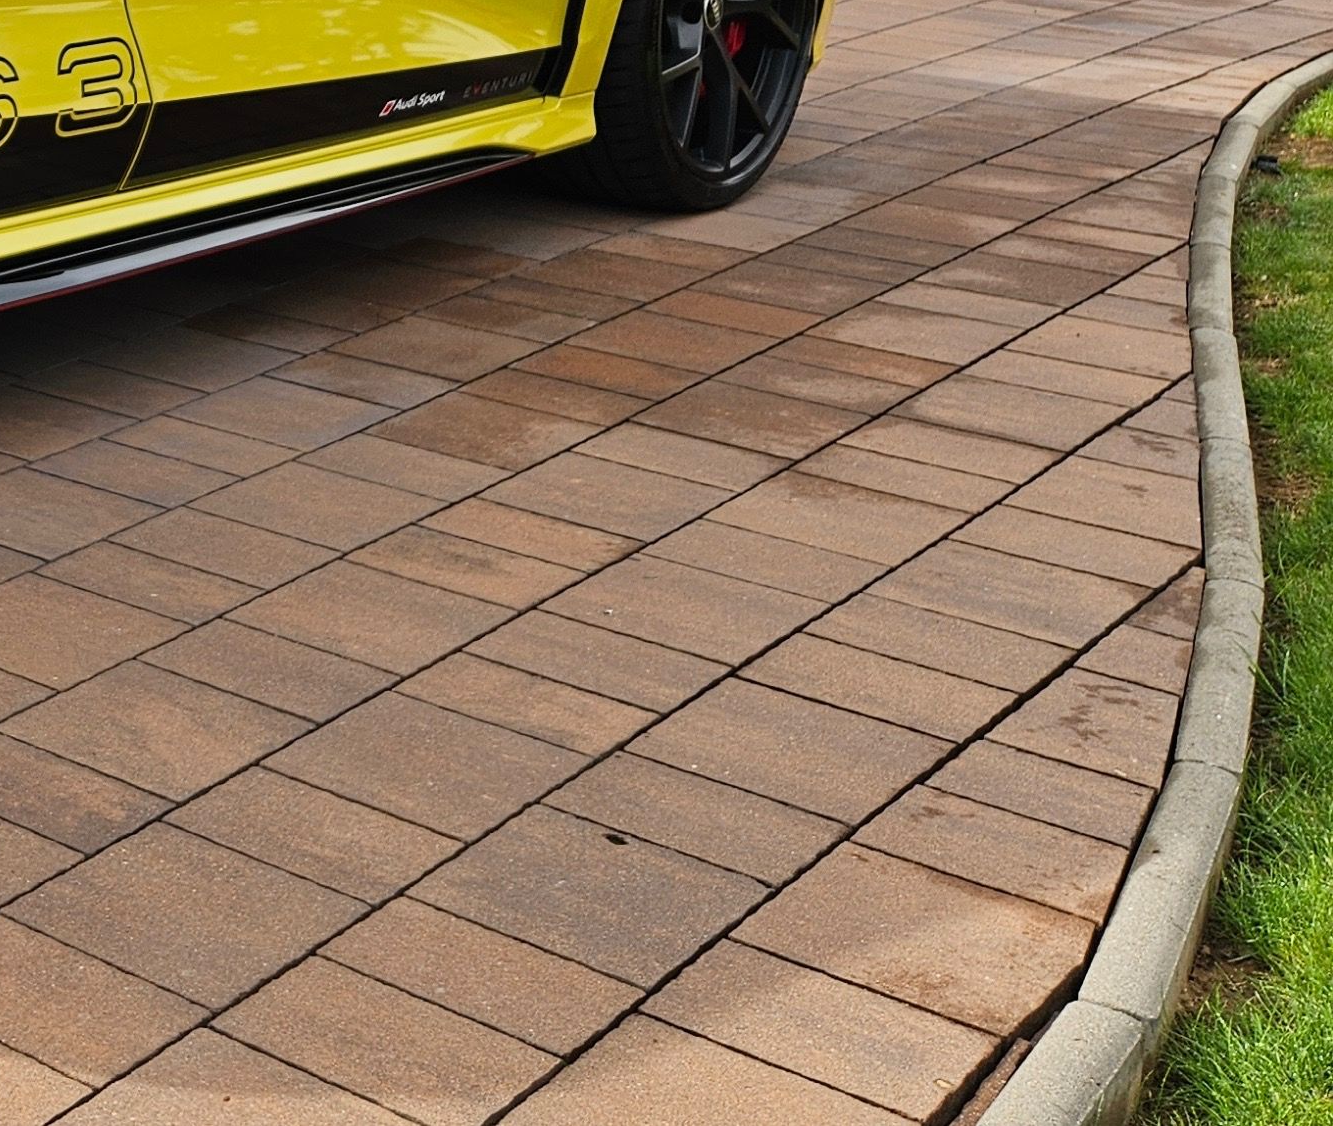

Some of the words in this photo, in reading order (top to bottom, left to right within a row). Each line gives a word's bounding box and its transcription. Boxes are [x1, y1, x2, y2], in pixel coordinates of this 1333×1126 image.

[55, 37, 137, 137] 3
[394, 95, 417, 112] Audi
[417, 90, 446, 108] Sport
